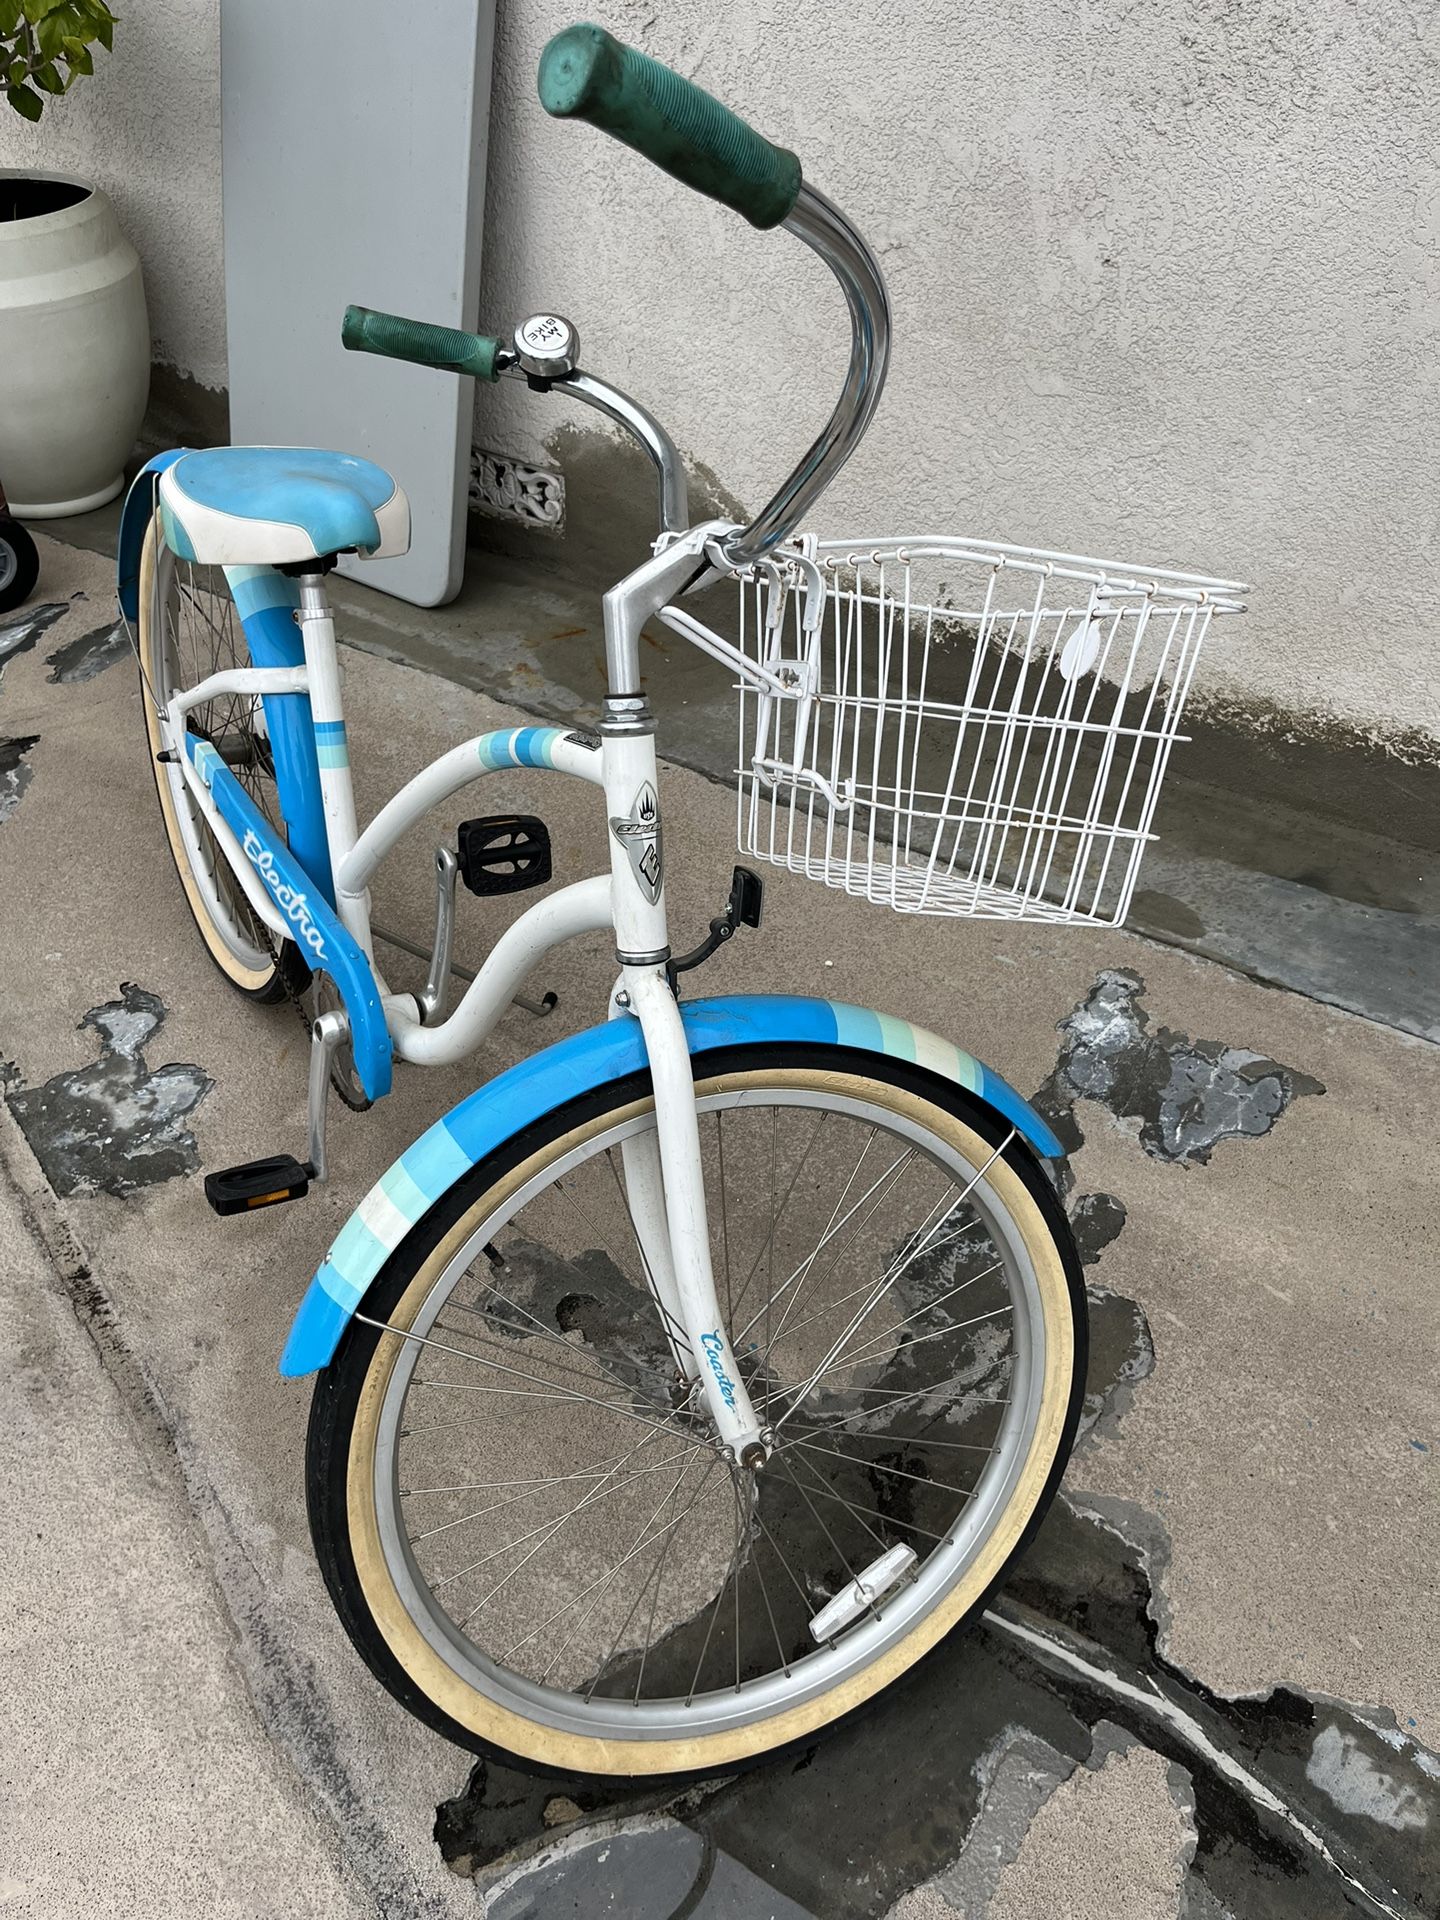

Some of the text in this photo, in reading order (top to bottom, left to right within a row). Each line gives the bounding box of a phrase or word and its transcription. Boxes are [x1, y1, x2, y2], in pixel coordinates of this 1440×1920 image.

[527, 318, 556, 341] BIKE
[541, 326, 559, 342] MY
[243, 828, 328, 961] Electra
[700, 1329, 735, 1413] Coaster
